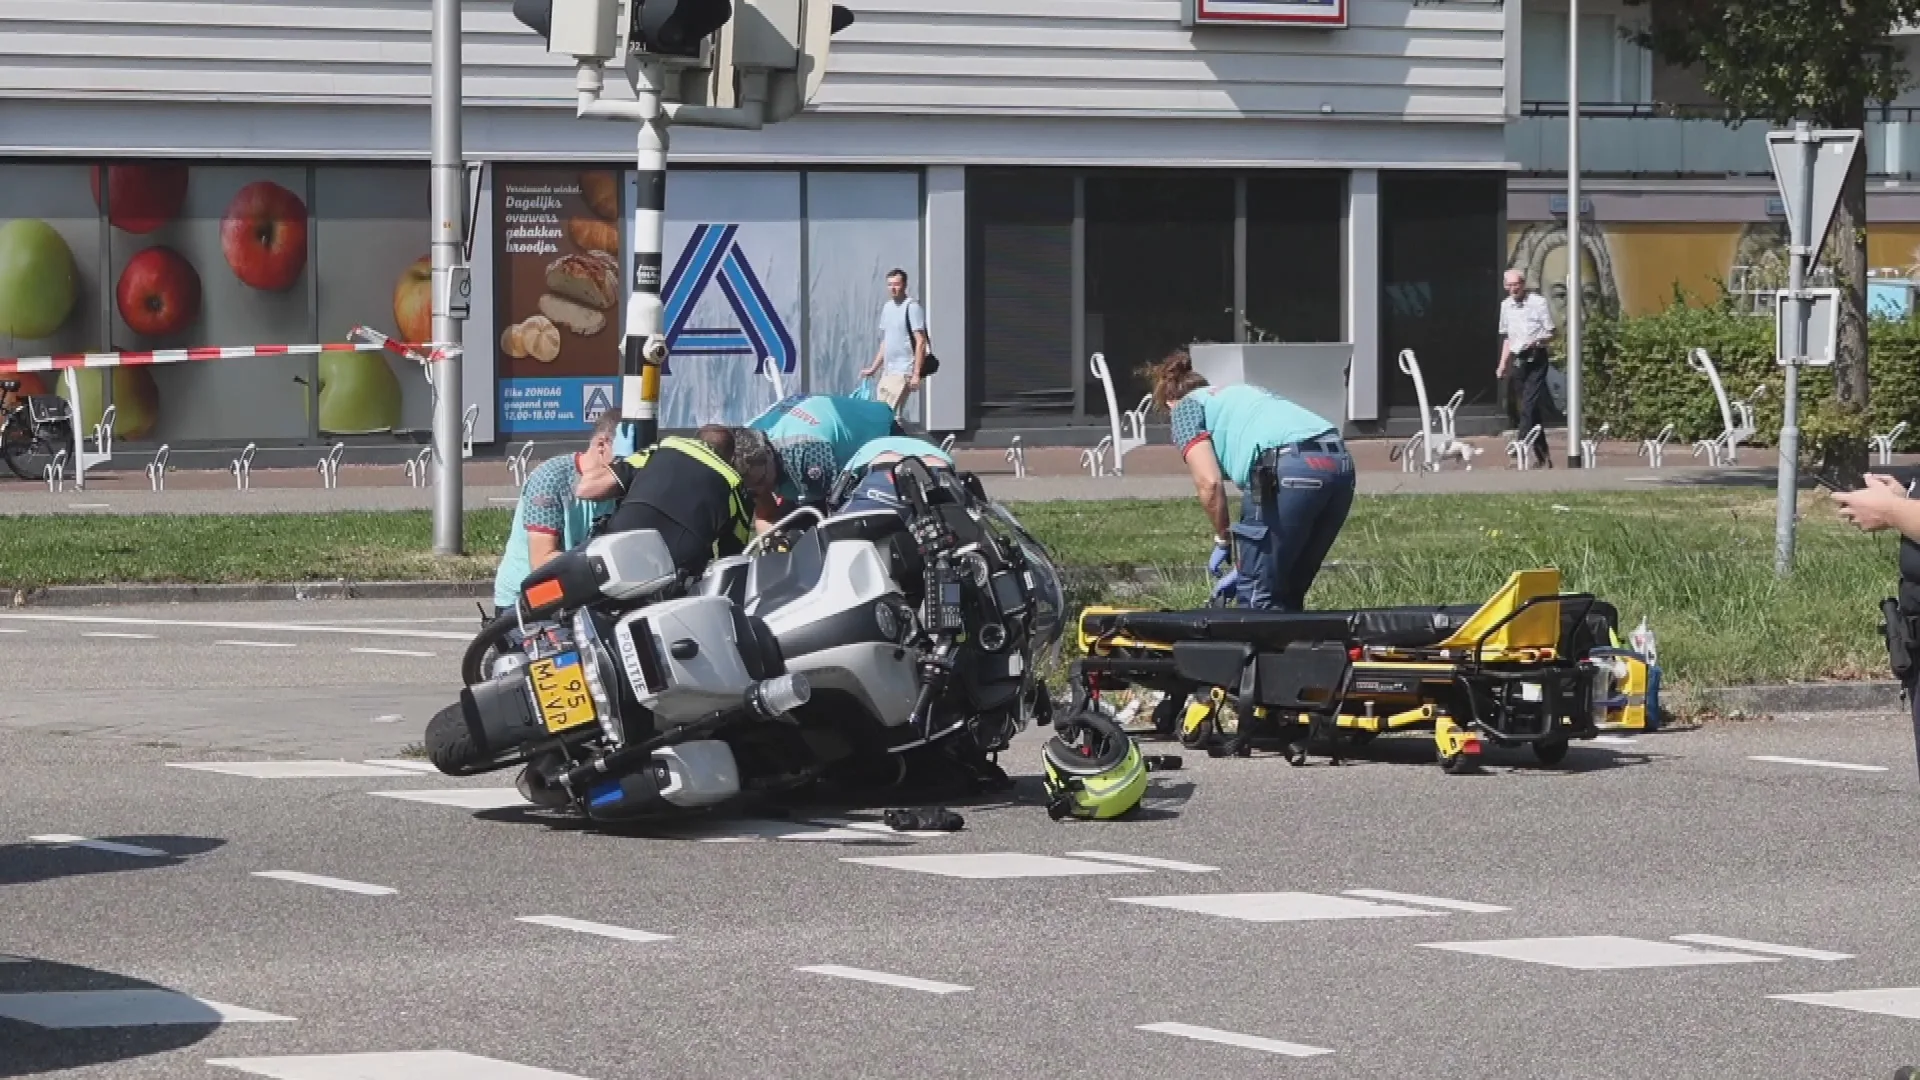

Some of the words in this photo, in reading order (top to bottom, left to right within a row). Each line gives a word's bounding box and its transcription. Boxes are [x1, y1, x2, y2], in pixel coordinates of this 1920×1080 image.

[505, 196, 562, 210] Dagelijks
[505, 214, 558, 223] ovenvers
[505, 226, 562, 241] gebakken
[505, 240, 558, 256] broodjes
[504, 387, 523, 397] Elke
[525, 387, 562, 397] ZONDAG
[542, 401, 560, 409] van
[620, 632, 647, 693] POLITIE
[563, 679, 586, 709] 95
